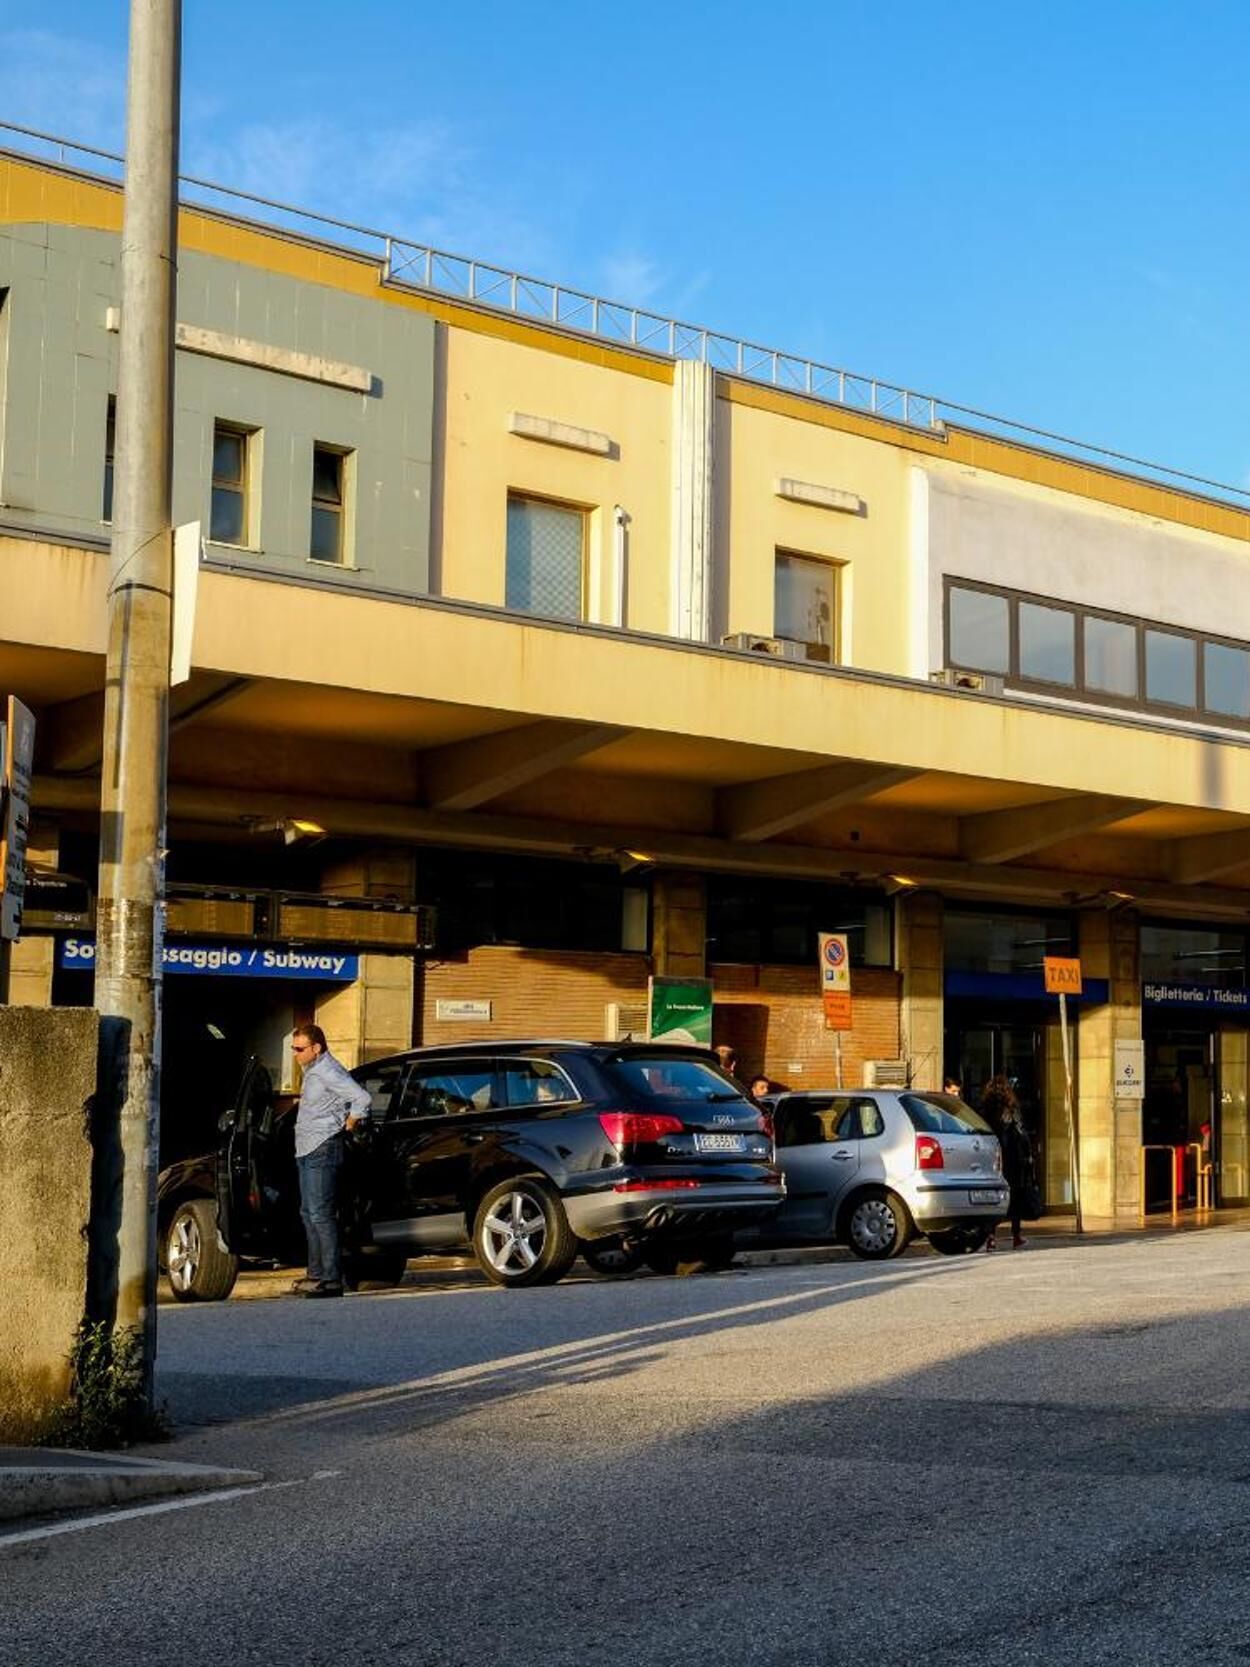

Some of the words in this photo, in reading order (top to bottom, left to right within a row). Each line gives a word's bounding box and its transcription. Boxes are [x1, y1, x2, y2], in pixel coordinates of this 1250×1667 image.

[248, 947, 257, 967] /
[262, 950, 346, 974] Subway
[1048, 966, 1079, 985] TAXI
[1144, 984, 1204, 1002] Biglietteria
[1213, 989, 1248, 1004] Tickets
